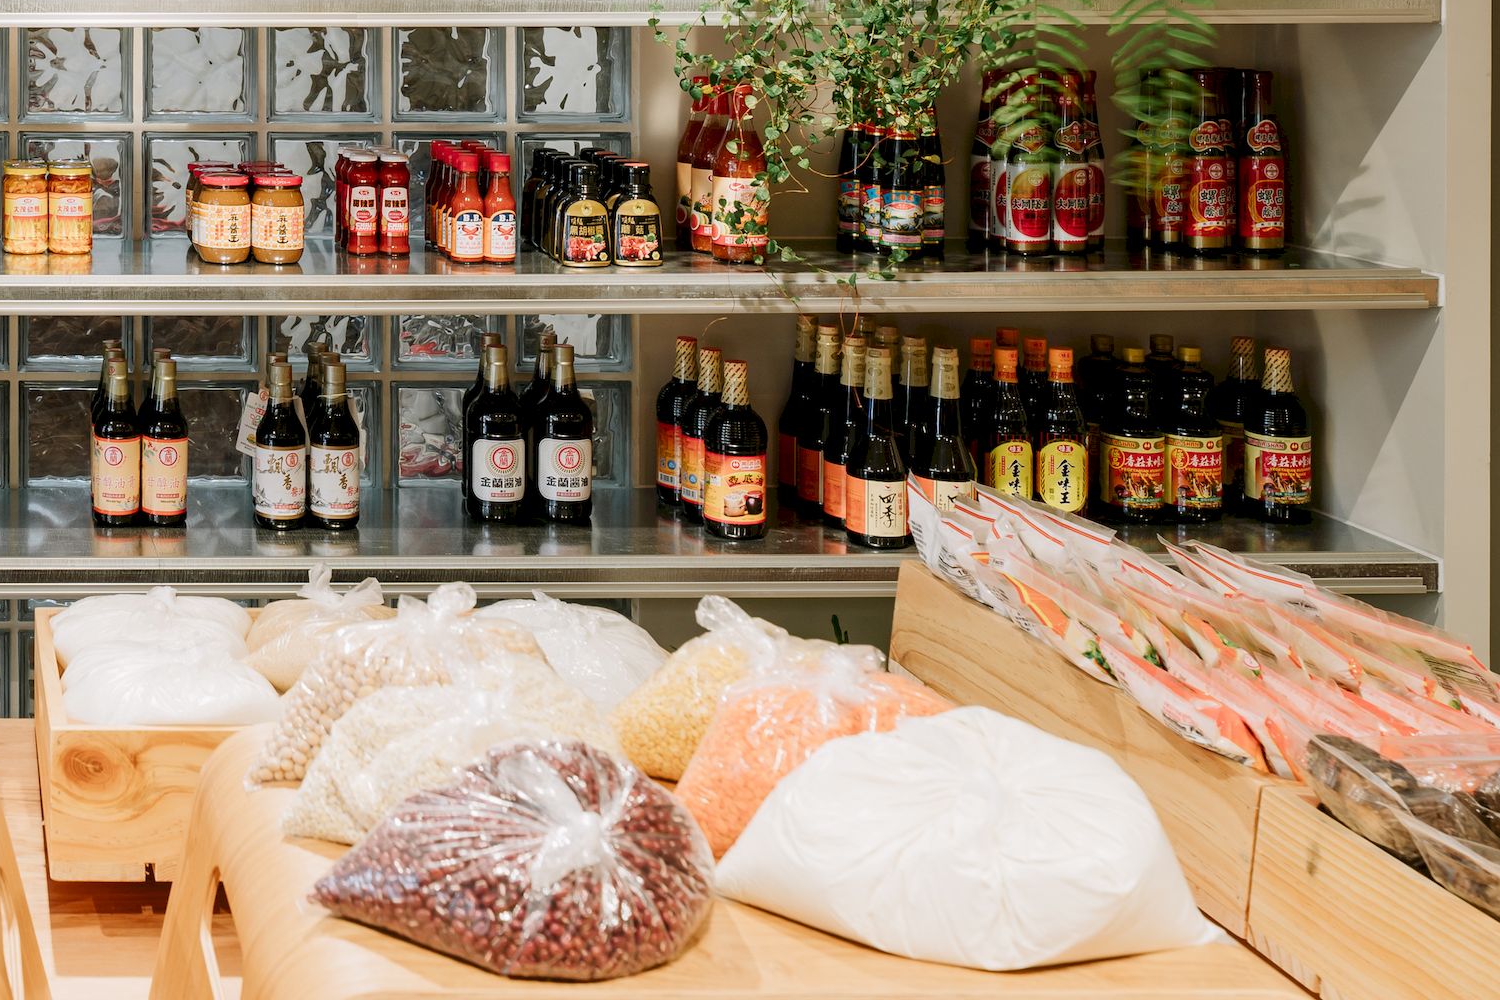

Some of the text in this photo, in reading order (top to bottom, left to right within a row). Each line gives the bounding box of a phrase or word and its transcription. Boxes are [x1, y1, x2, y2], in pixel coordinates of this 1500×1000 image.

[480, 476, 522, 488] 金蘭醬油
[546, 475, 588, 488] 金蘭醬油
[1057, 459, 1075, 504] 金味王
